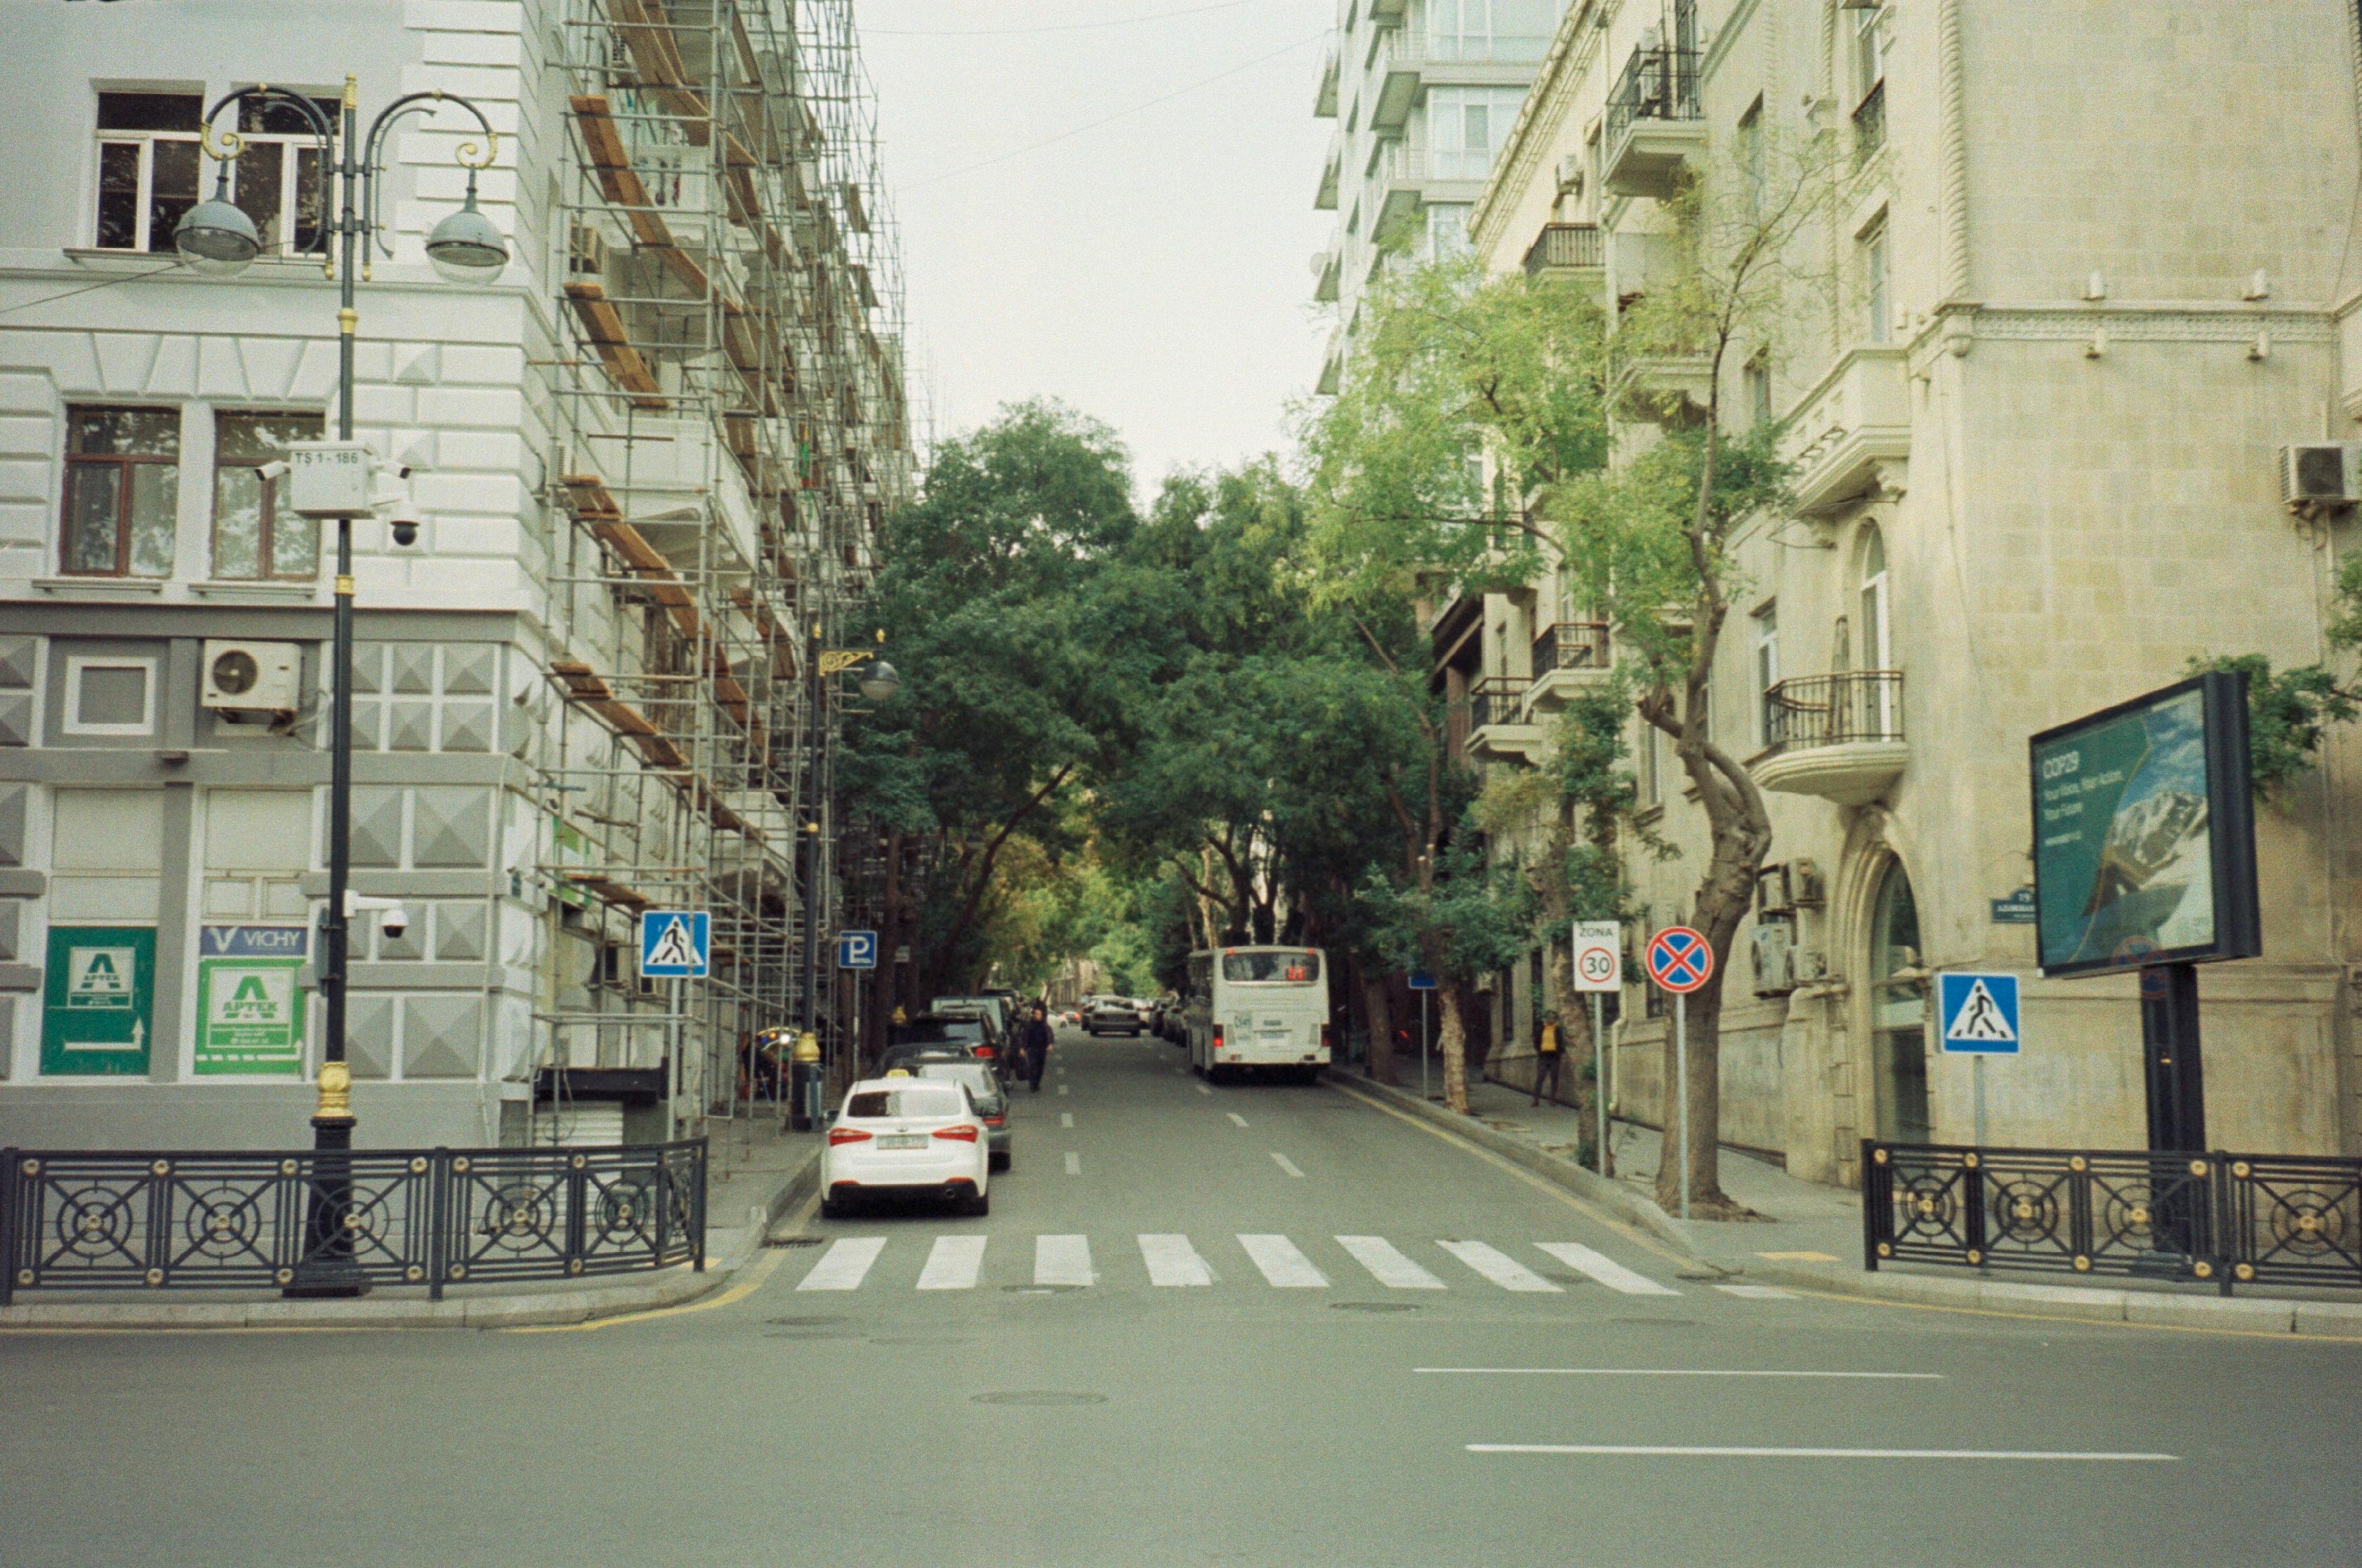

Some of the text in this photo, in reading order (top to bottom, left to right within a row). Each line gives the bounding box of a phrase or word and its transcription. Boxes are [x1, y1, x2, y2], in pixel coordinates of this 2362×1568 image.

[243, 930, 301, 947] VICHY
[1579, 928, 1614, 937] ZONA
[1585, 957, 1610, 974] 30
[223, 1001, 278, 1012] APTEK
